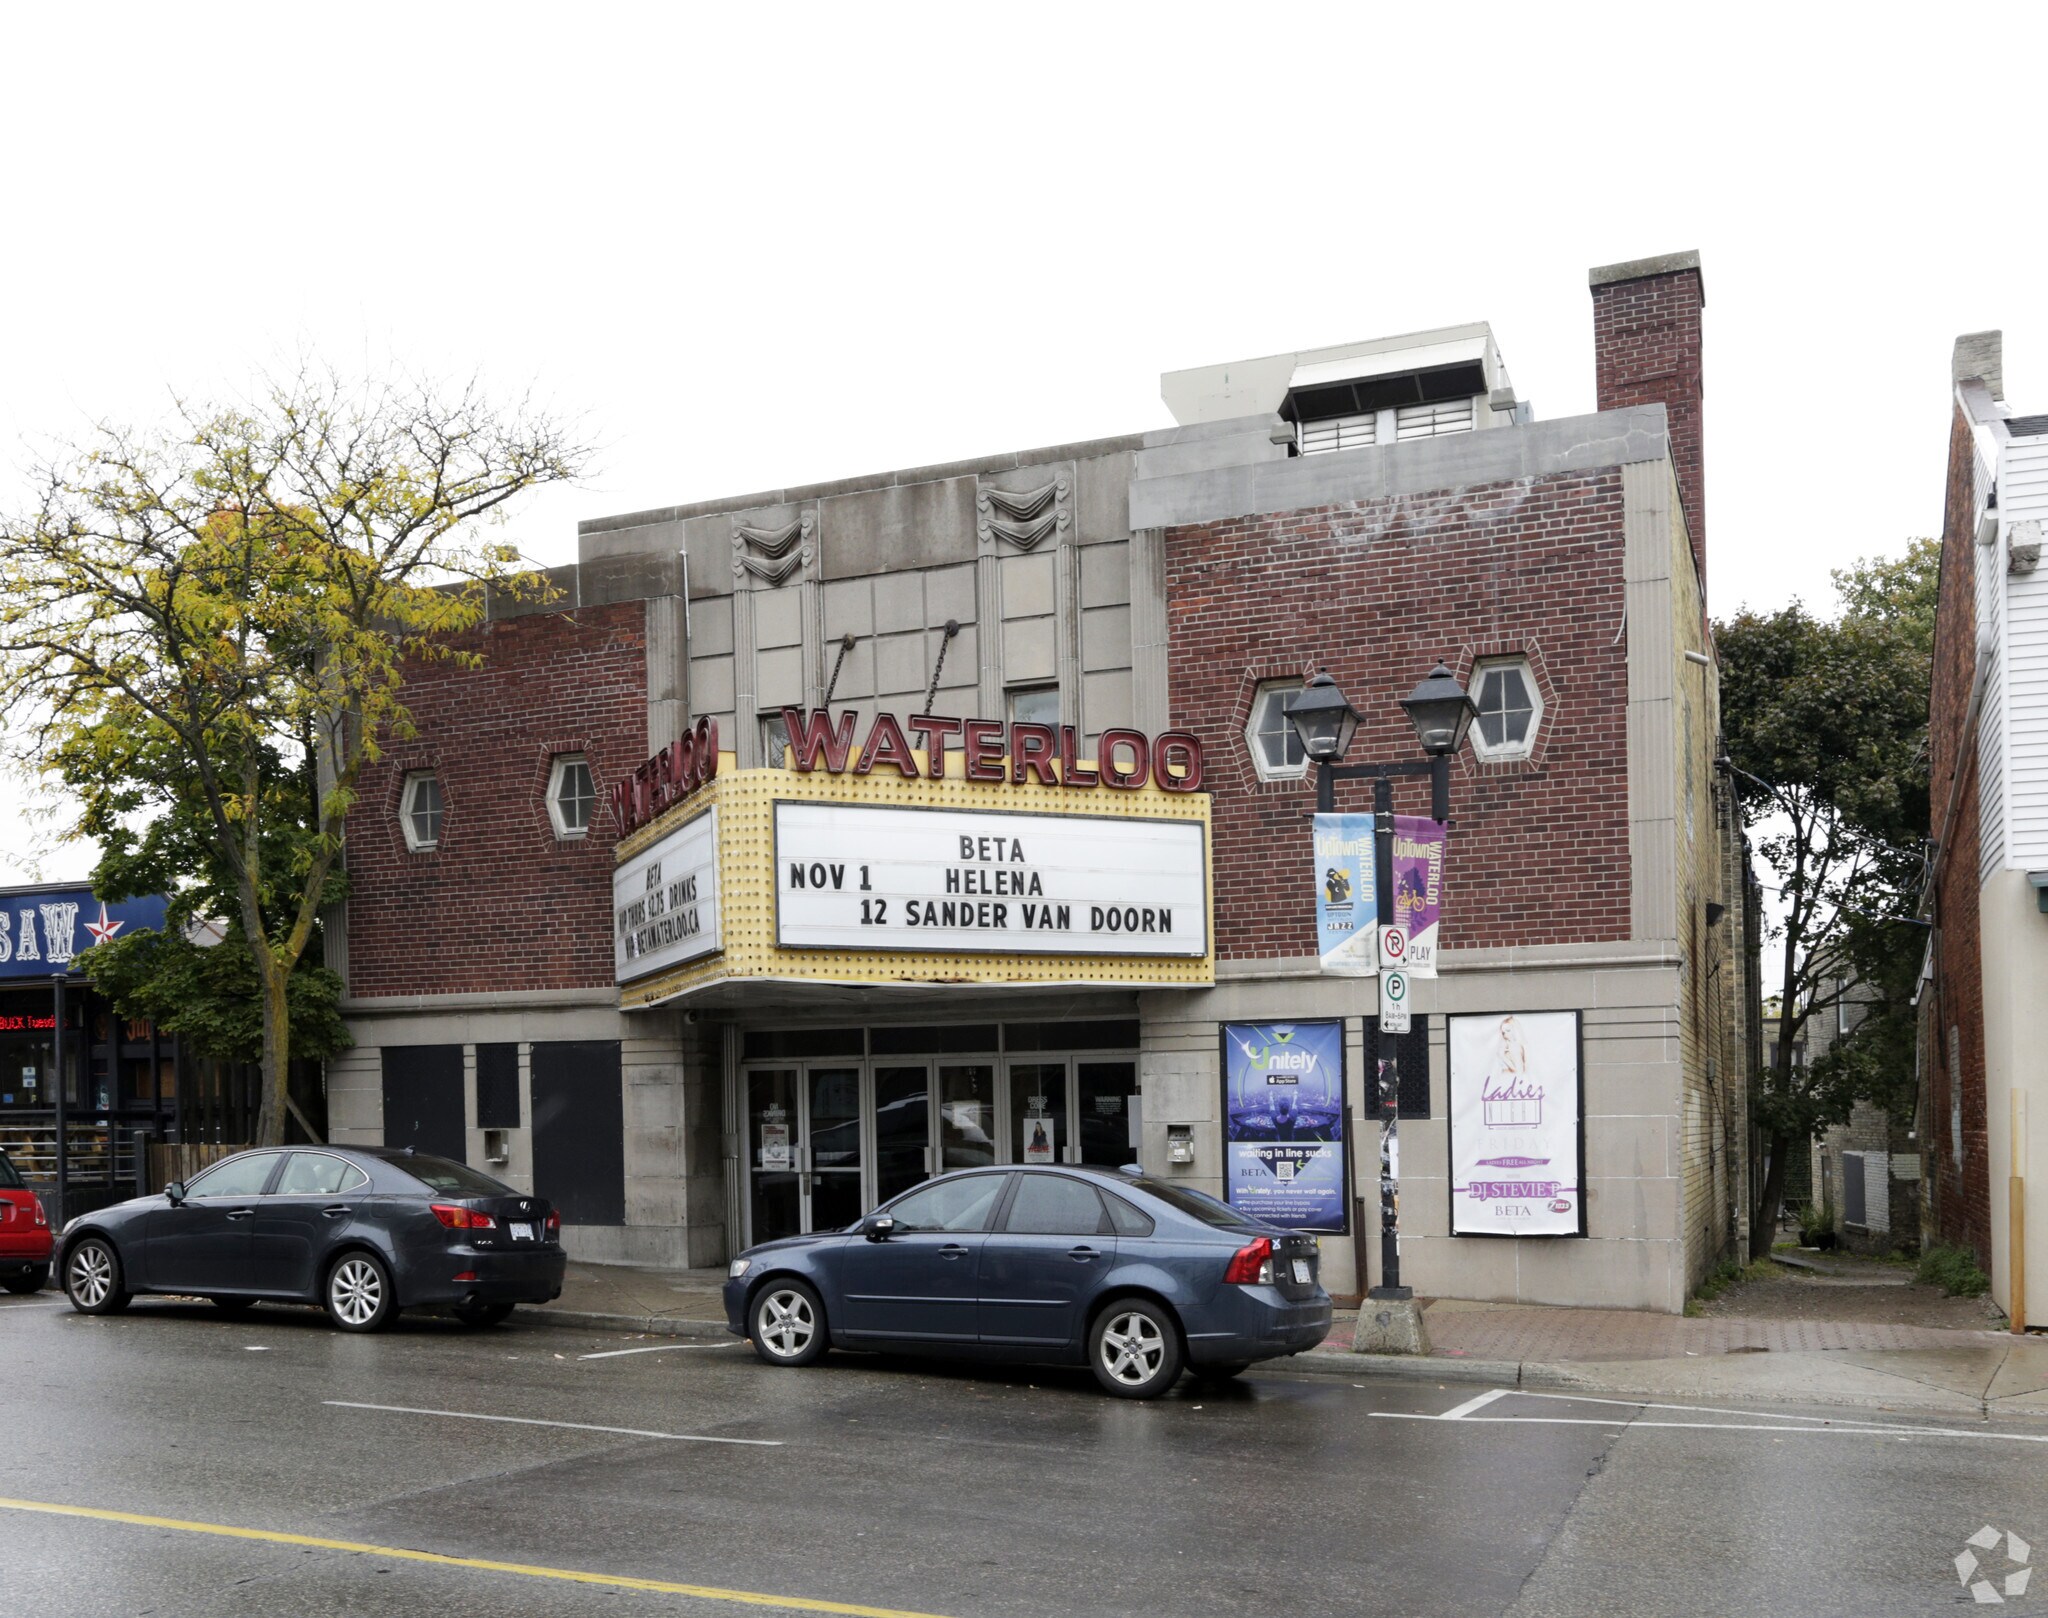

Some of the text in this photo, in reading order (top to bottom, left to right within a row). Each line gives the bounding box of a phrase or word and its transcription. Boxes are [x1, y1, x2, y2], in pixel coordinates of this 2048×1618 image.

[781, 705, 1203, 793] WATERLOO
[959, 834, 1026, 863] BETA
[1316, 836, 1359, 859] UpTown
[1393, 836, 1430, 860] UpTown
[646, 861, 662, 892] BETA
[790, 862, 1044, 896] NOV 1 HELENA
[1358, 837, 1375, 902] WATERLOO
[1426, 841, 1443, 906] WATERLOO
[669, 874, 697, 911] DRINKS
[860, 898, 1172, 933] 12 SANDER VAN DOORN
[1327, 922, 1353, 930] JAZZ
[1410, 945, 1431, 961] PLAY
[1392, 980, 1401, 994] P
[1250, 1046, 1318, 1074] Unitely
[1481, 1075, 1546, 1101] Ladies
[1488, 1101, 1538, 1122] NIGHT
[1238, 1148, 1332, 1159] waiting in line sucks
[1477, 1136, 1551, 1150] FRIDAY
[1241, 1168, 1267, 1177] BETA
[1502, 1158, 1519, 1166] FREE
[1469, 1182, 1561, 1200] DJ STEVIE P
[1495, 1205, 1532, 1216] BETA
